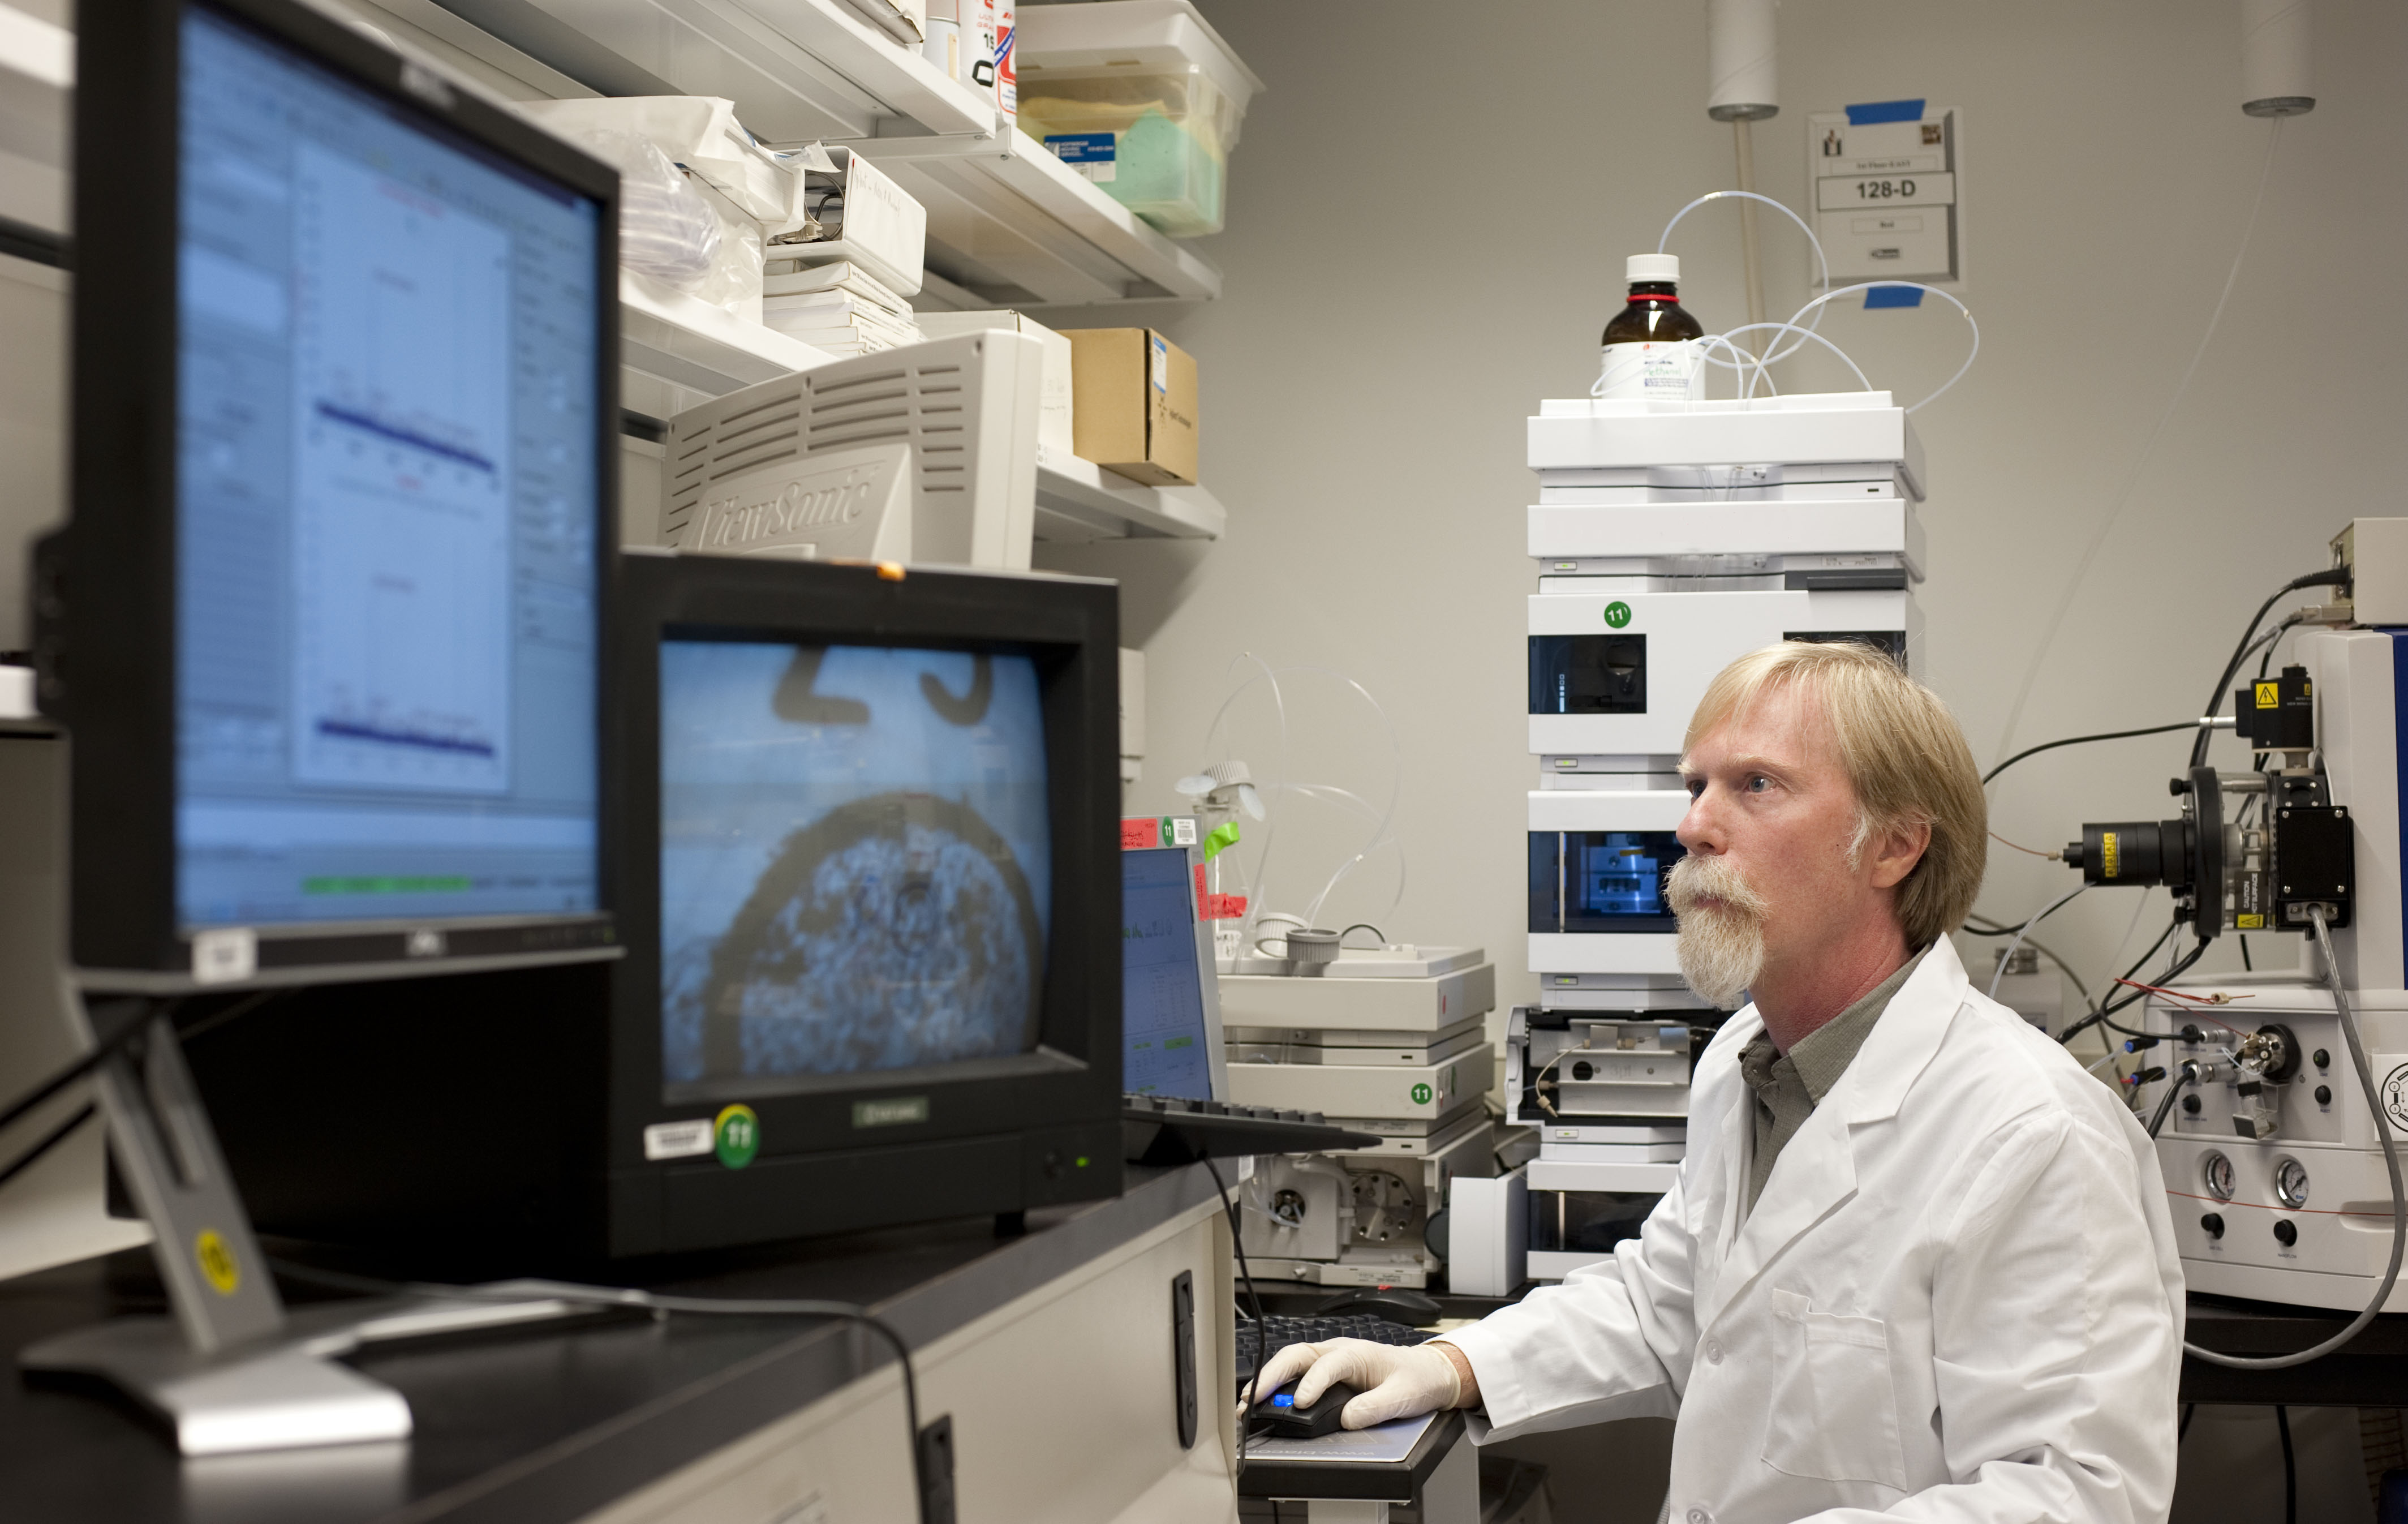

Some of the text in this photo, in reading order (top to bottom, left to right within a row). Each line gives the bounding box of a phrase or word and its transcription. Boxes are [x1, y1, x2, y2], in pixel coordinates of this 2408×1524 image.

[1856, 180, 1916, 199] 128-D
[698, 469, 870, 552] ViewSonic
[1608, 608, 1623, 621] 11
[1164, 825, 1171, 837] 11
[1414, 1088, 1428, 1100] 11
[728, 1122, 752, 1148] 11
